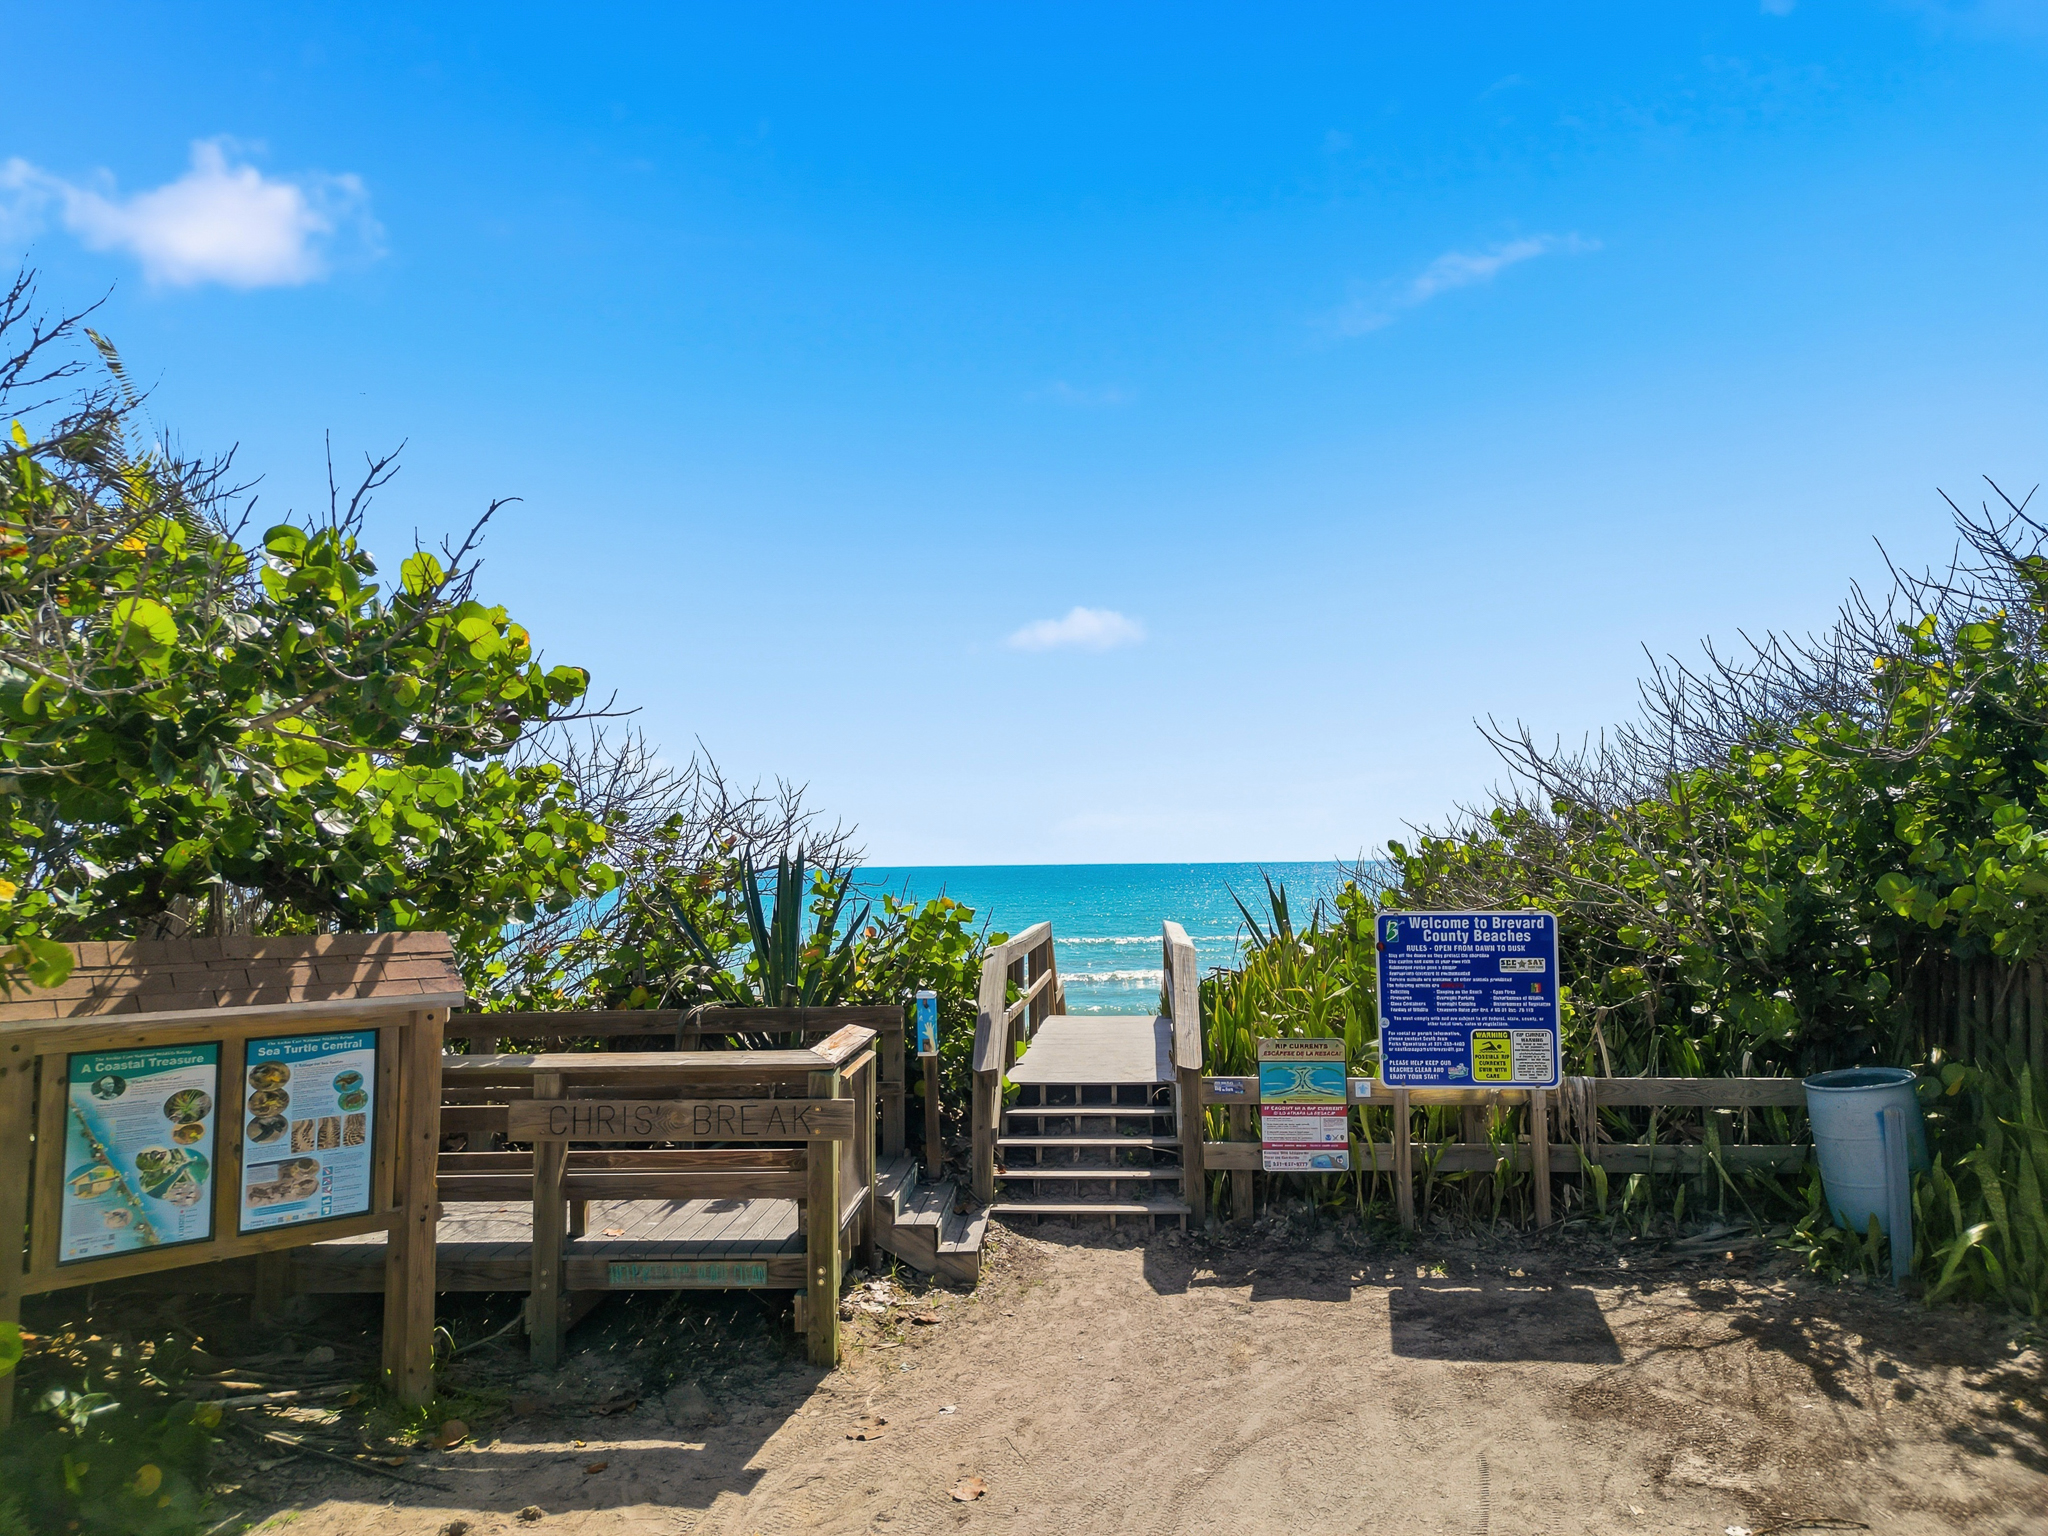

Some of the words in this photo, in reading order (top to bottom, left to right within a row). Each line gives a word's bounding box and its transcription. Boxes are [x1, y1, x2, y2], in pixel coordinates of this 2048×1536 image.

[1409, 917, 1469, 929] Welcome
[1474, 917, 1487, 929] to
[1492, 917, 1544, 929] Brevard
[1423, 930, 1469, 944] County
[1474, 930, 1531, 941] Beaches
[258, 1047, 280, 1056] Sea
[284, 1044, 318, 1054] Turtle
[322, 1039, 362, 1050] Central
[81, 1064, 91, 1074] A
[95, 1059, 144, 1072] Coastal
[148, 1056, 204, 1067] Treasure
[550, 1105, 662, 1136] CHRIS'
[693, 1105, 811, 1136] BREAK
